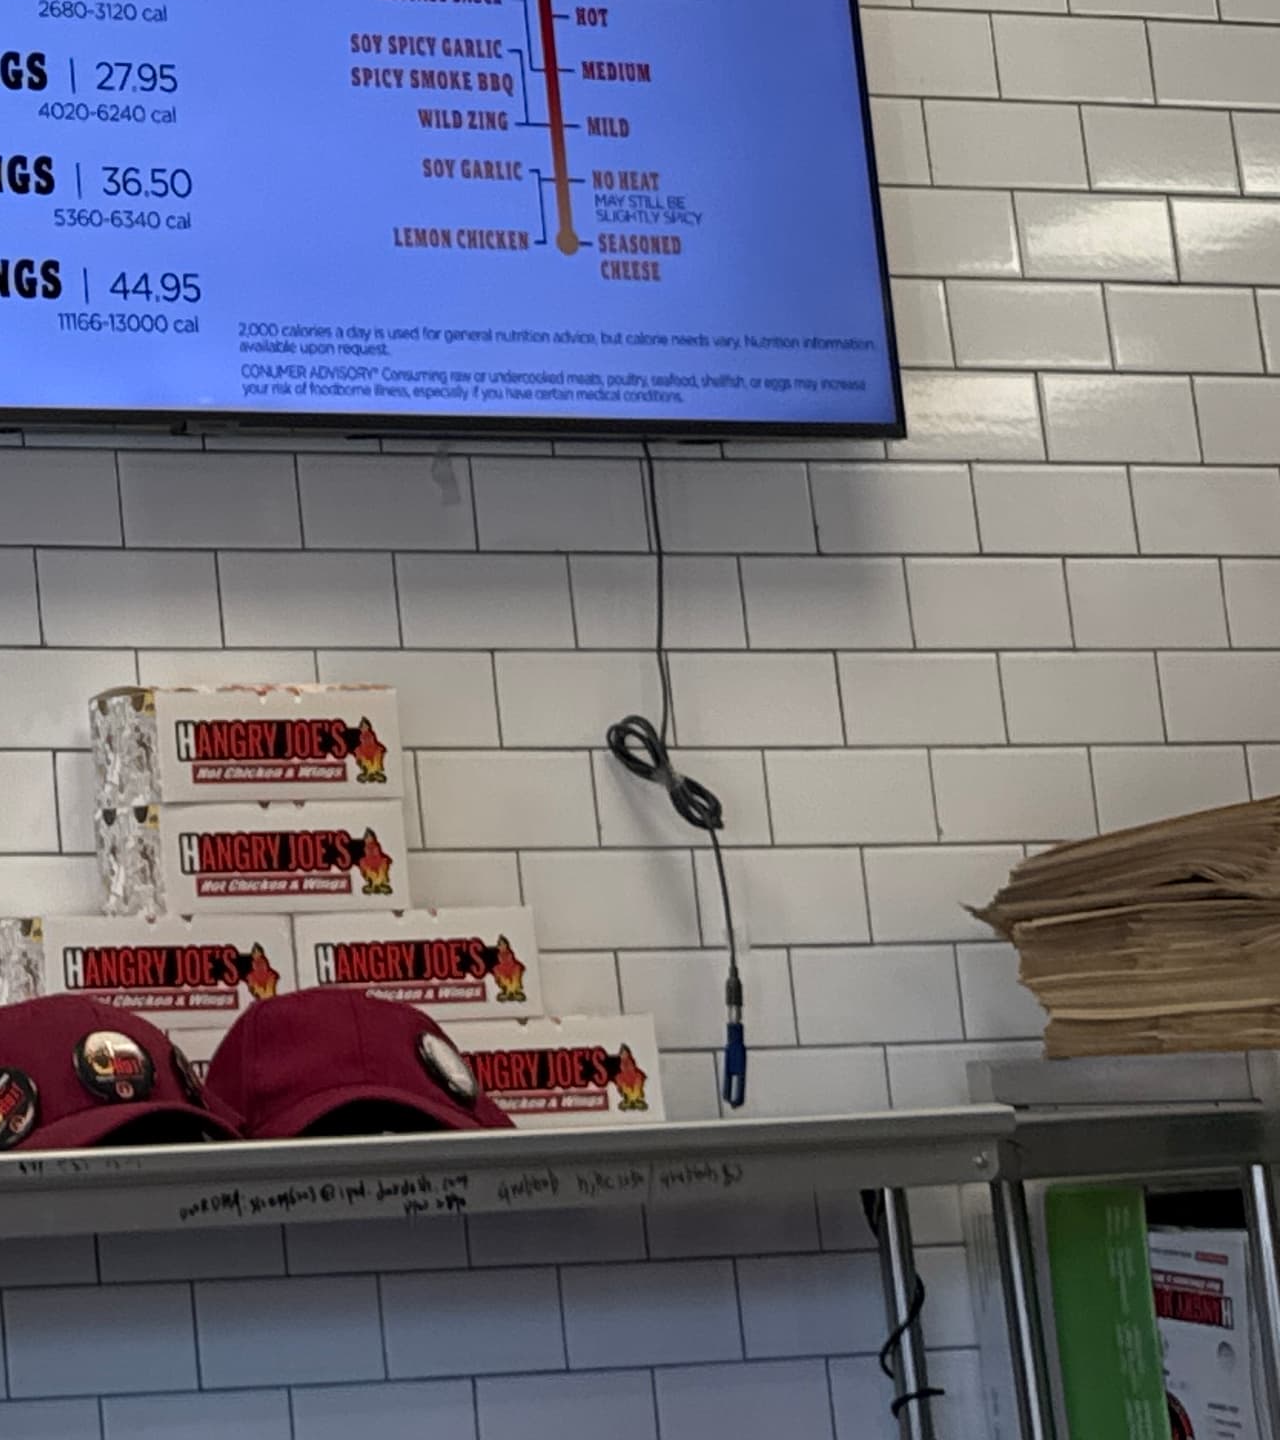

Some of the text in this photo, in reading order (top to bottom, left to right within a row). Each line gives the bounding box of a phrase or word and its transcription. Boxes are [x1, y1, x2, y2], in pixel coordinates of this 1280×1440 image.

[96, 62, 177, 93] 27.95
[582, 61, 651, 82] MEDIUM
[418, 109, 508, 130] WILD ZING
[102, 167, 192, 198] 36.50
[394, 228, 529, 250] LEMON CHICKEN
[110, 272, 200, 302] 44.95
[176, 720, 348, 761] HANGRY JOE'S
[179, 830, 352, 873] HANGRY JOE'S
